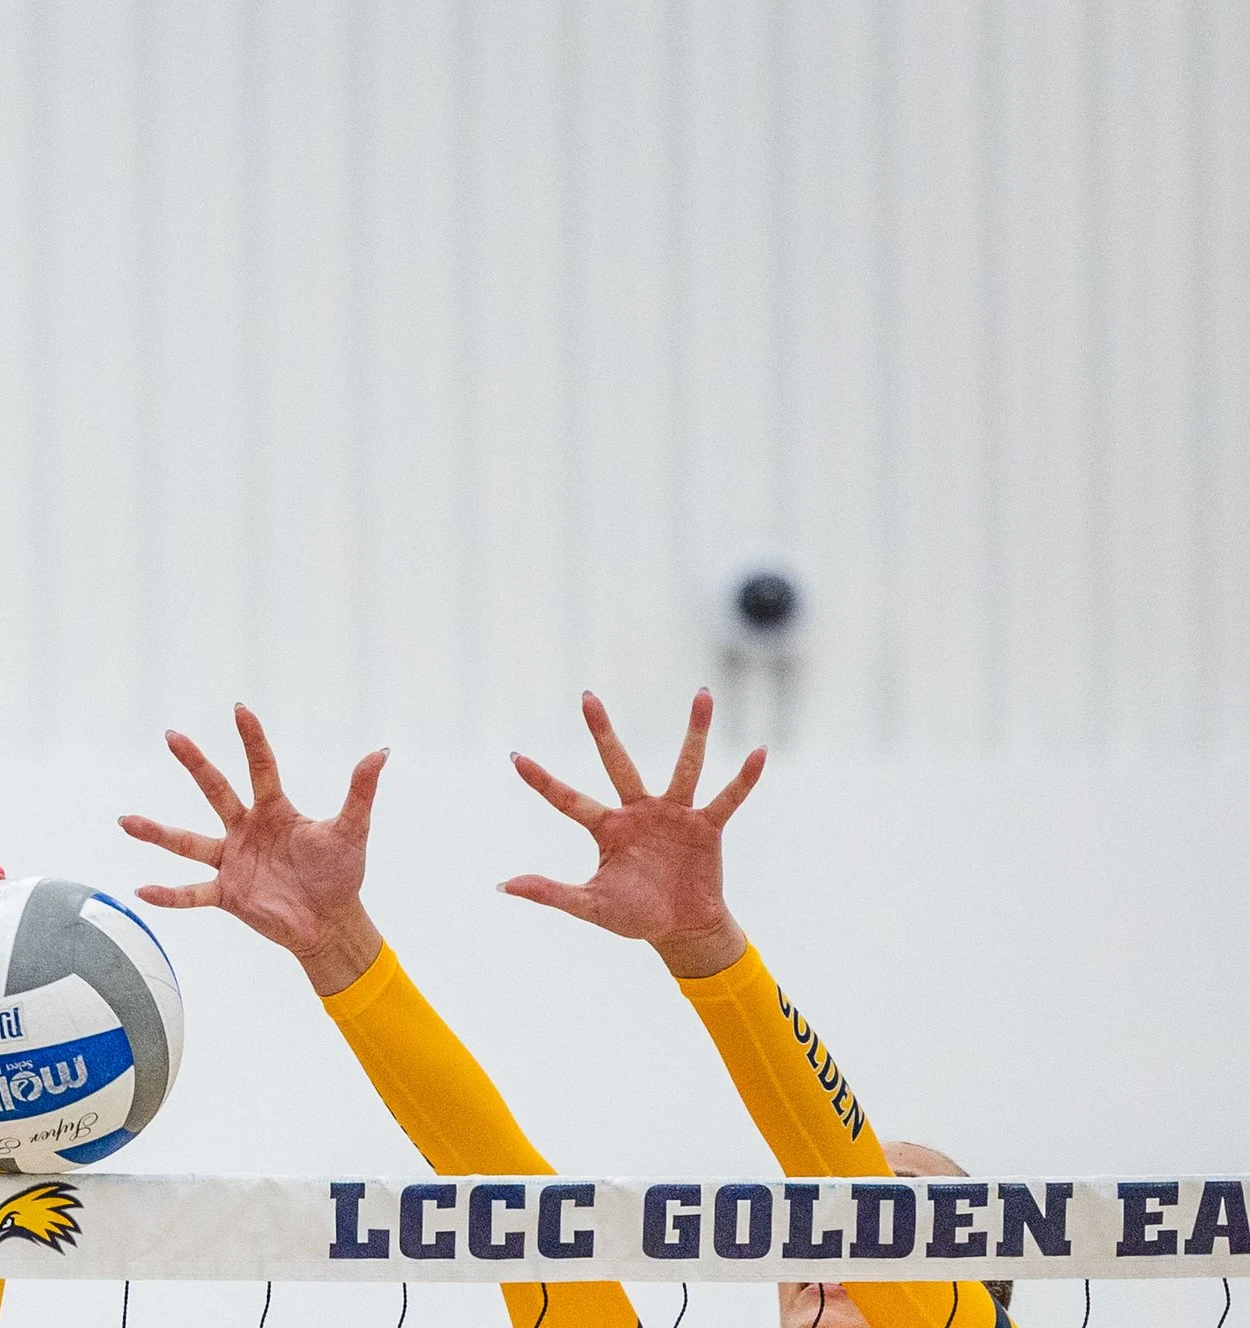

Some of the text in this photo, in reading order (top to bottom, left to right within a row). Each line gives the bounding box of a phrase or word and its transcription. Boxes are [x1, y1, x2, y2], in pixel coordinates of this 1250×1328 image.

[6, 1059, 34, 1073] Select
[29, 1112, 99, 1143] Super
[328, 1180, 1250, 1260] LCCC GOLDEN EA
